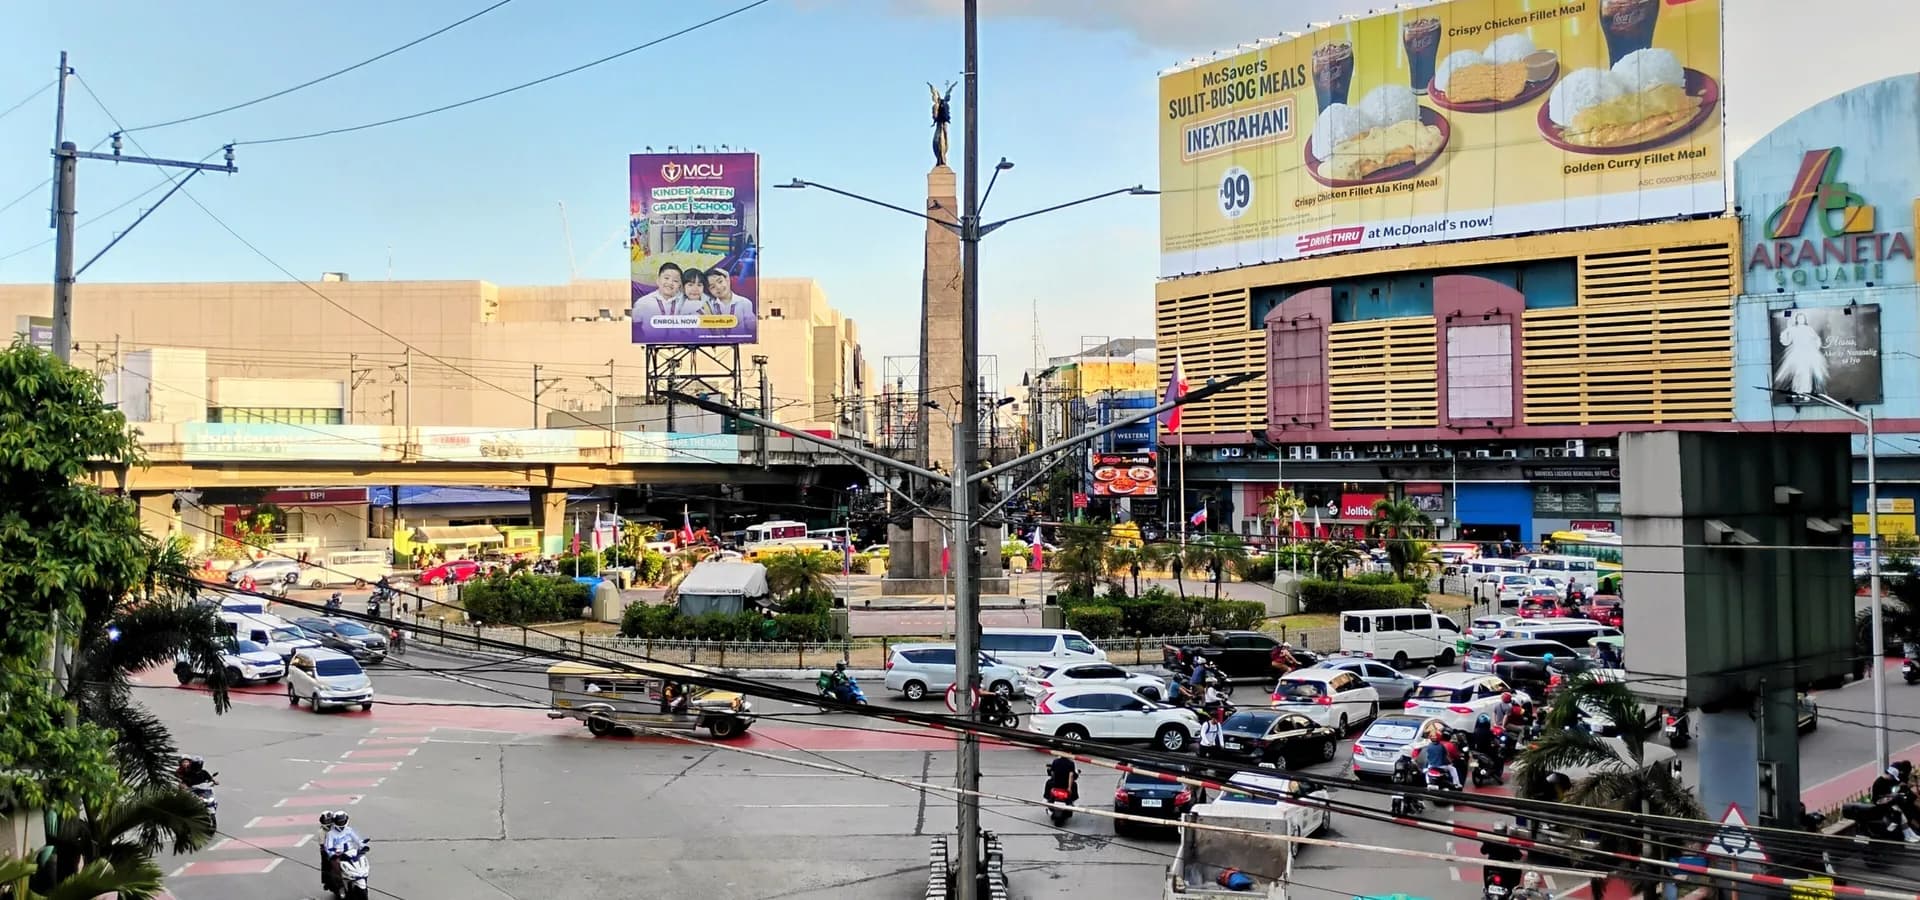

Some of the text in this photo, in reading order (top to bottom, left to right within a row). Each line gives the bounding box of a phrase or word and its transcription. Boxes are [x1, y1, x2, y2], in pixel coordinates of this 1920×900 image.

[1449, 3, 1585, 37] Crispy Chicken Fillet Meal
[1203, 59, 1268, 88] McSavers
[1169, 64, 1306, 120] SULIT-BUSOG MEALS
[1188, 107, 1289, 153] INEXTRAHAN!
[683, 164, 723, 177] MCU
[1564, 147, 1706, 175] Golden Curry Fillet Meal
[653, 187, 733, 197] KINDERGARTEN
[1295, 178, 1438, 208] Crispy Chicken Fillet Ala King Meal
[1639, 178, 1654, 187] ASC
[653, 202, 734, 212] GRADE SCHOOL
[1310, 215, 1493, 248] DRIVE-THRU at McDonald's now!
[1750, 232, 1913, 270] ARANETA
[1775, 264, 1884, 286] SQUARE
[310, 492, 325, 500] BPI
[1345, 505, 1376, 516] Jollibe
